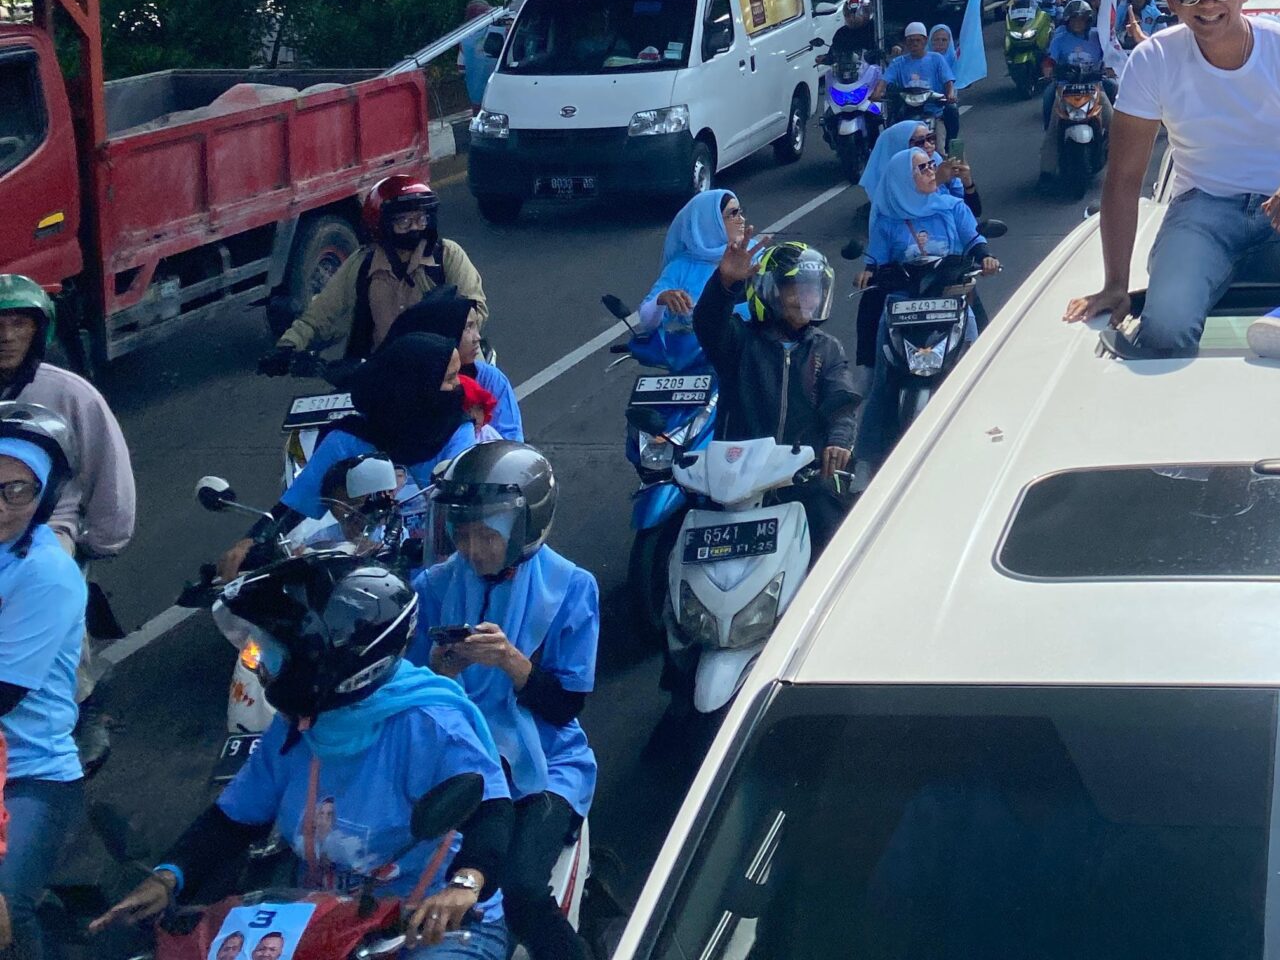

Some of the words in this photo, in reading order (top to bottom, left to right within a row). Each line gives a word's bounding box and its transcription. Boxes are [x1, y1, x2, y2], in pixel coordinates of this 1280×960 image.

[638, 379, 646, 390] F
[656, 378, 685, 389] 5209
[694, 377, 709, 388] CS
[685, 531, 694, 546] F
[703, 525, 739, 545] 6541
[756, 522, 776, 537] MS
[229, 740, 241, 756] 9
[247, 910, 277, 929] 3
